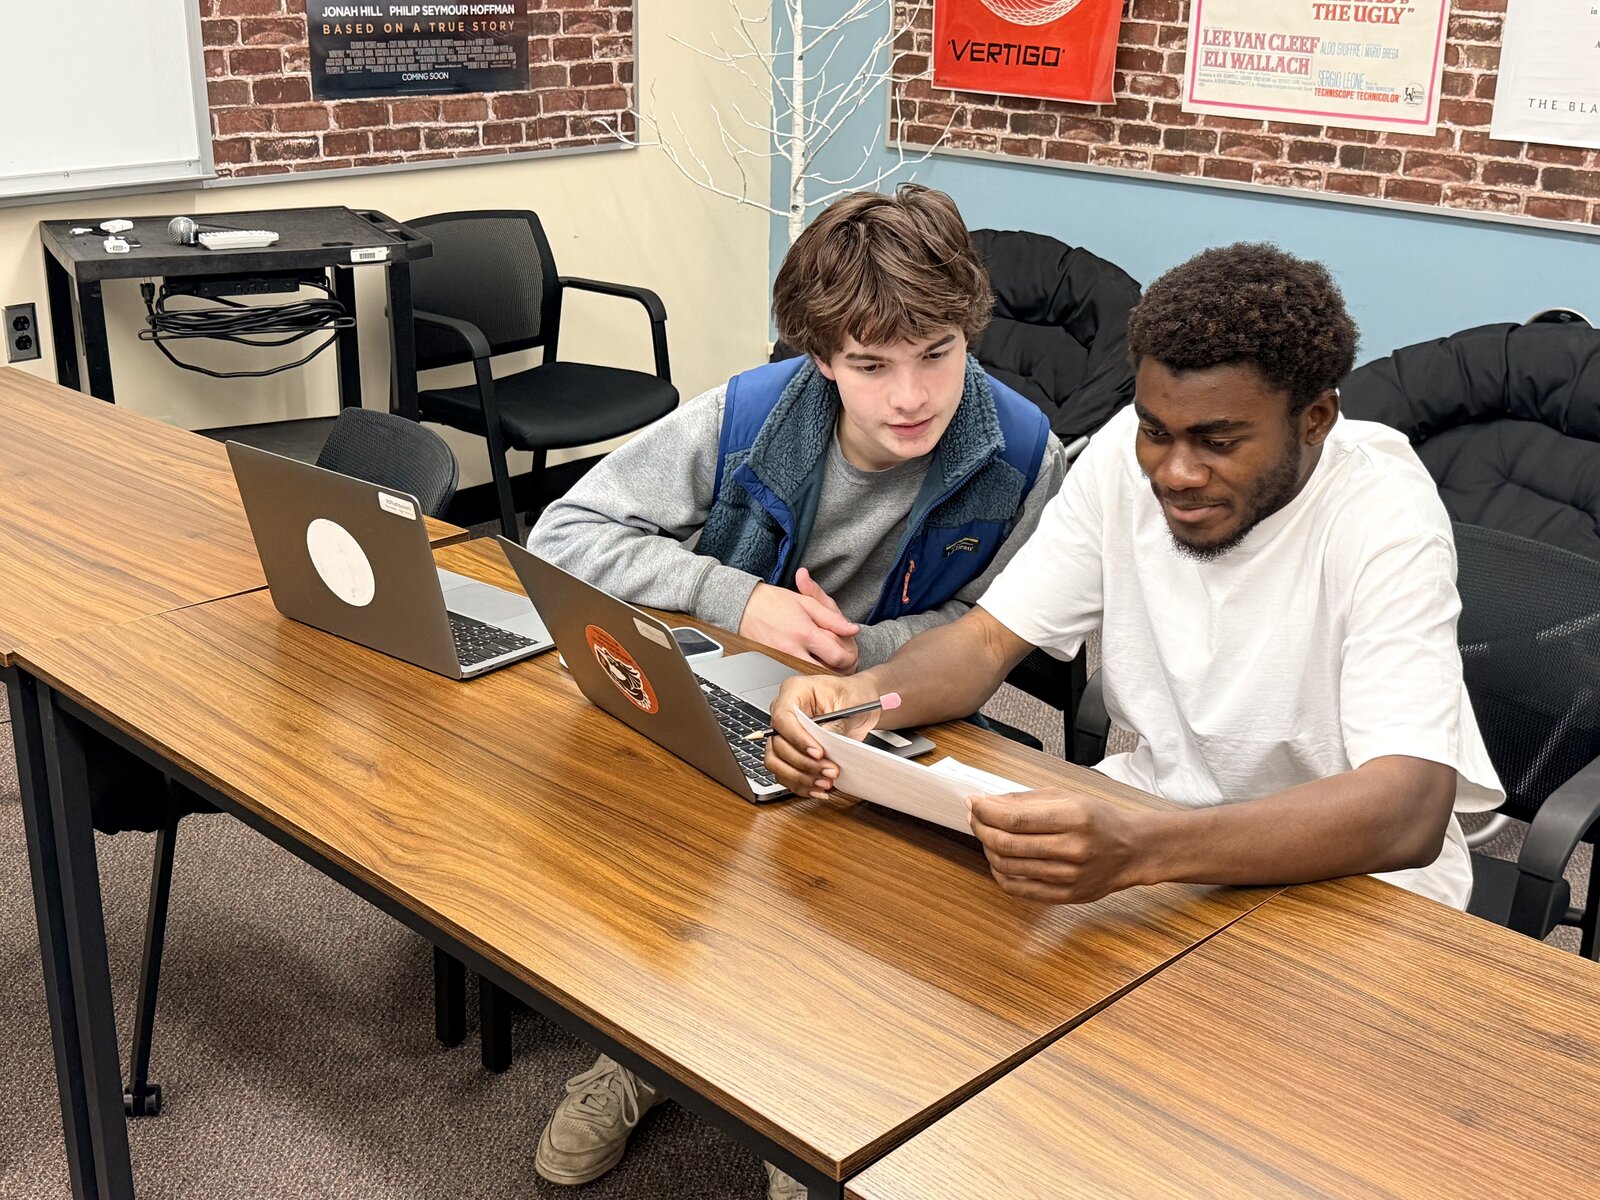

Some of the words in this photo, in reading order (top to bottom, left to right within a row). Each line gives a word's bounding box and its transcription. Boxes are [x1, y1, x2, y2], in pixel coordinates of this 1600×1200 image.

[322, 6, 358, 17] JONAH
[360, 6, 383, 16] HILL
[389, 5, 420, 16] PHILIP
[422, 5, 468, 15] SEYMOUR
[470, 4, 515, 15] HOFFMAN
[1312, 3, 1351, 21] THE
[322, 22, 374, 34] BASED
[383, 22, 403, 33] ON
[412, 22, 420, 33] A
[429, 22, 465, 32] TRUE
[472, 20, 515, 31] STORY
[1202, 29, 1232, 47] LEE
[1233, 31, 1267, 50] VAN
[1268, 33, 1321, 54] CLEEF
[1320, 41, 1336, 56] ALDO
[1203, 50, 1228, 68] ELI
[1229, 52, 1311, 75] WALLACH
[402, 73, 429, 81] COMING
[429, 72, 449, 80] SOON
[1317, 70, 1342, 88] SERGIO
[1342, 72, 1365, 90] LEONE
[1314, 87, 1355, 100] TECHNISCOPE
[1356, 91, 1400, 103] TECHNICOLOR
[1528, 98, 1558, 110] THE
